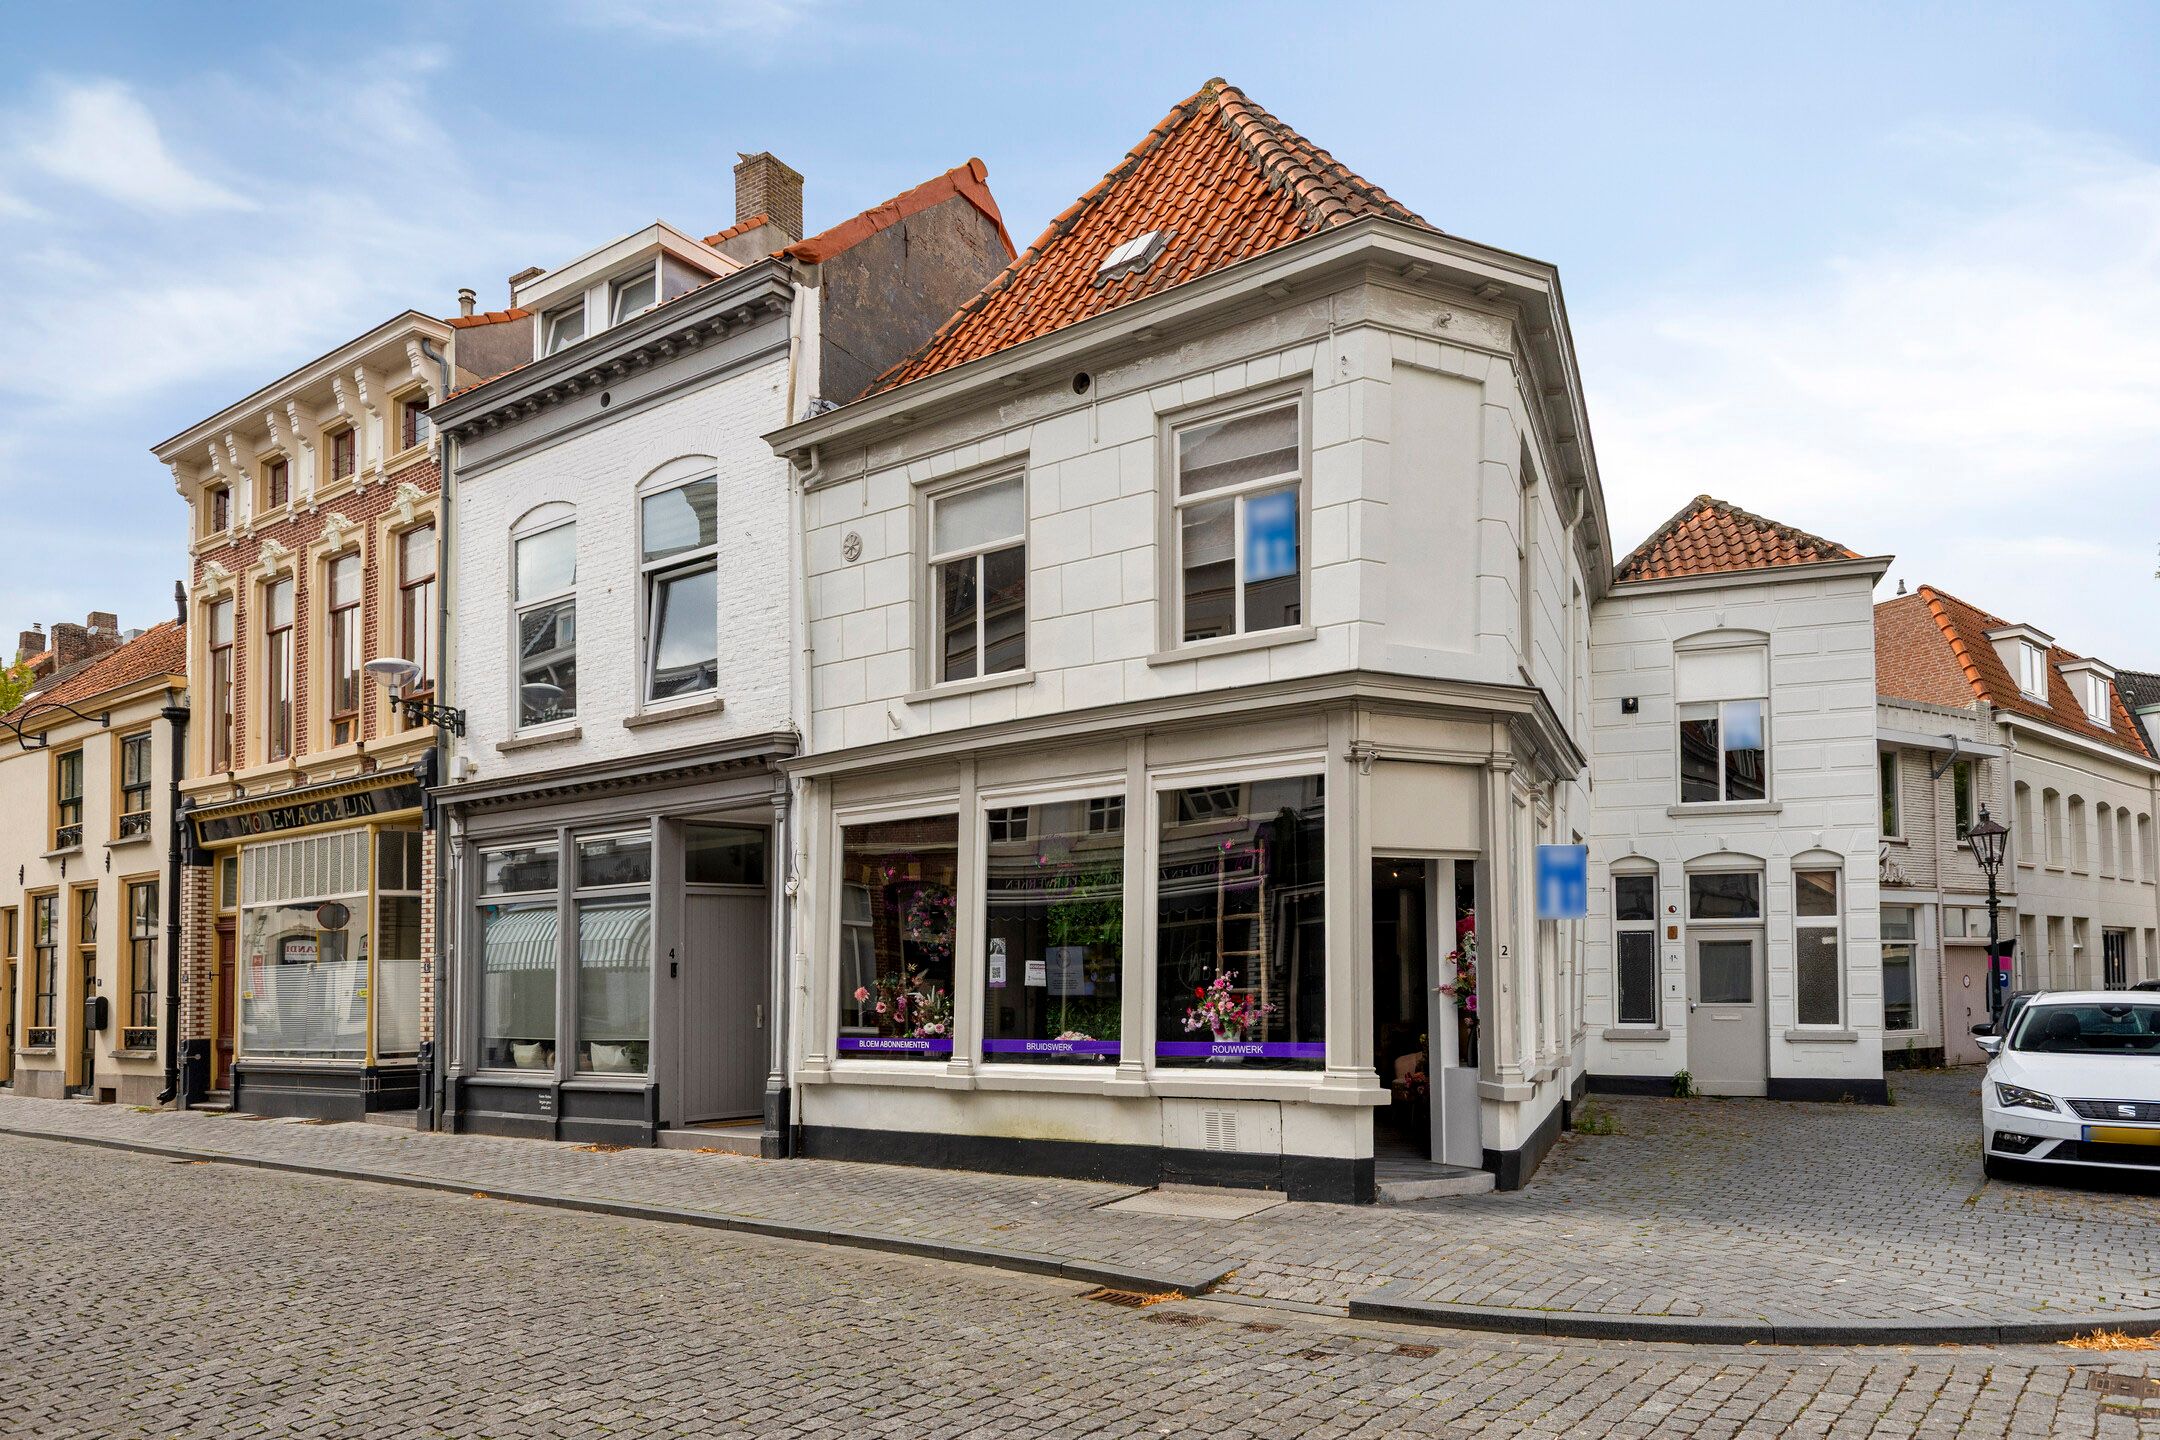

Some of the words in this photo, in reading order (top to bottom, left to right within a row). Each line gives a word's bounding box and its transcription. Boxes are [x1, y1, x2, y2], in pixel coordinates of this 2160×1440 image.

[669, 948, 675, 959] 4
[1501, 945, 1508, 956] 2
[859, 1040, 880, 1048] BLOEM
[880, 1040, 930, 1049] ABONNEMENTEN
[1026, 1042, 1073, 1051] BRUIDSWERK
[1211, 1045, 1264, 1054] ROUWWERK
